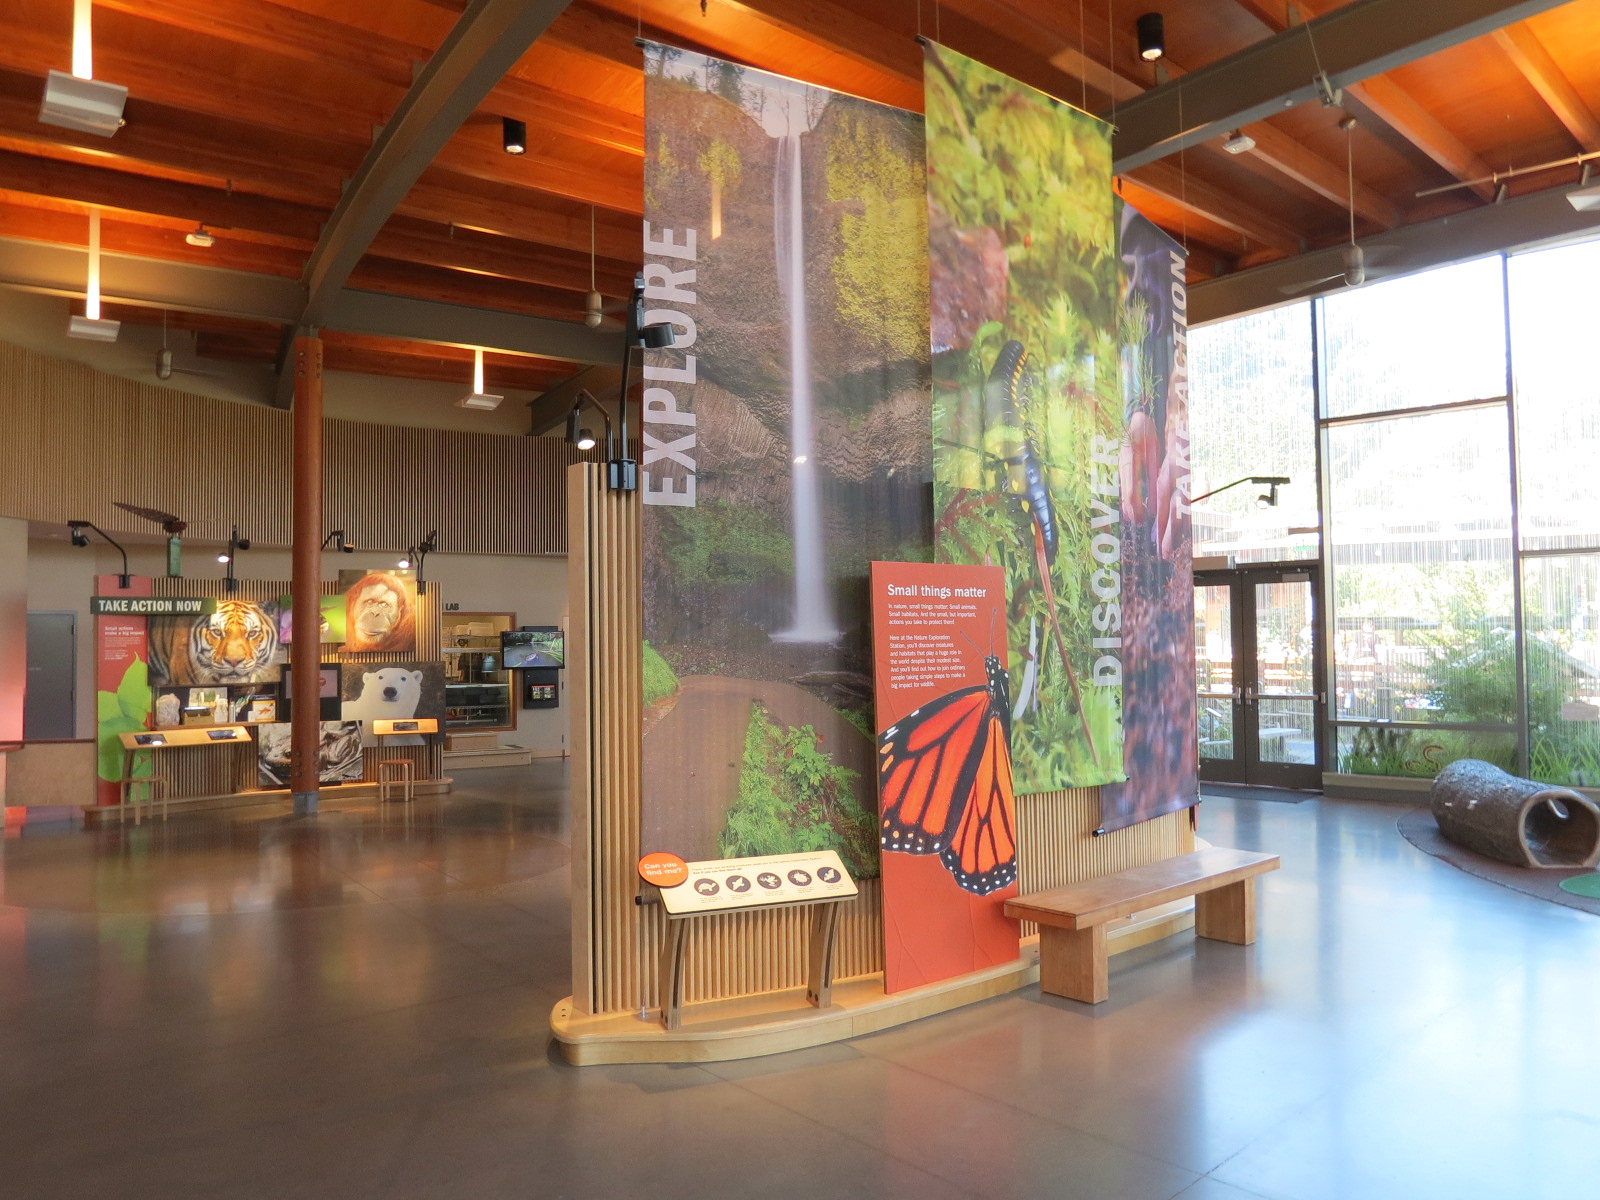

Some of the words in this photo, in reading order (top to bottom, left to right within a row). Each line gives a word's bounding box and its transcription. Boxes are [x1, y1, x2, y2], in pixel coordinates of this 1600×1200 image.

[642, 219, 696, 508] EXPLORE
[1170, 249, 1188, 406] ACTION
[1174, 411, 1192, 519] TAKE
[98, 600, 128, 612] TAKE
[130, 600, 172, 612] ACTION
[176, 601, 202, 612] NOW
[445, 603, 460, 611] LAB
[887, 584, 918, 596] Small
[920, 585, 952, 599] things
[954, 587, 986, 598] matter
[1090, 434, 1122, 687] DISCOVER
